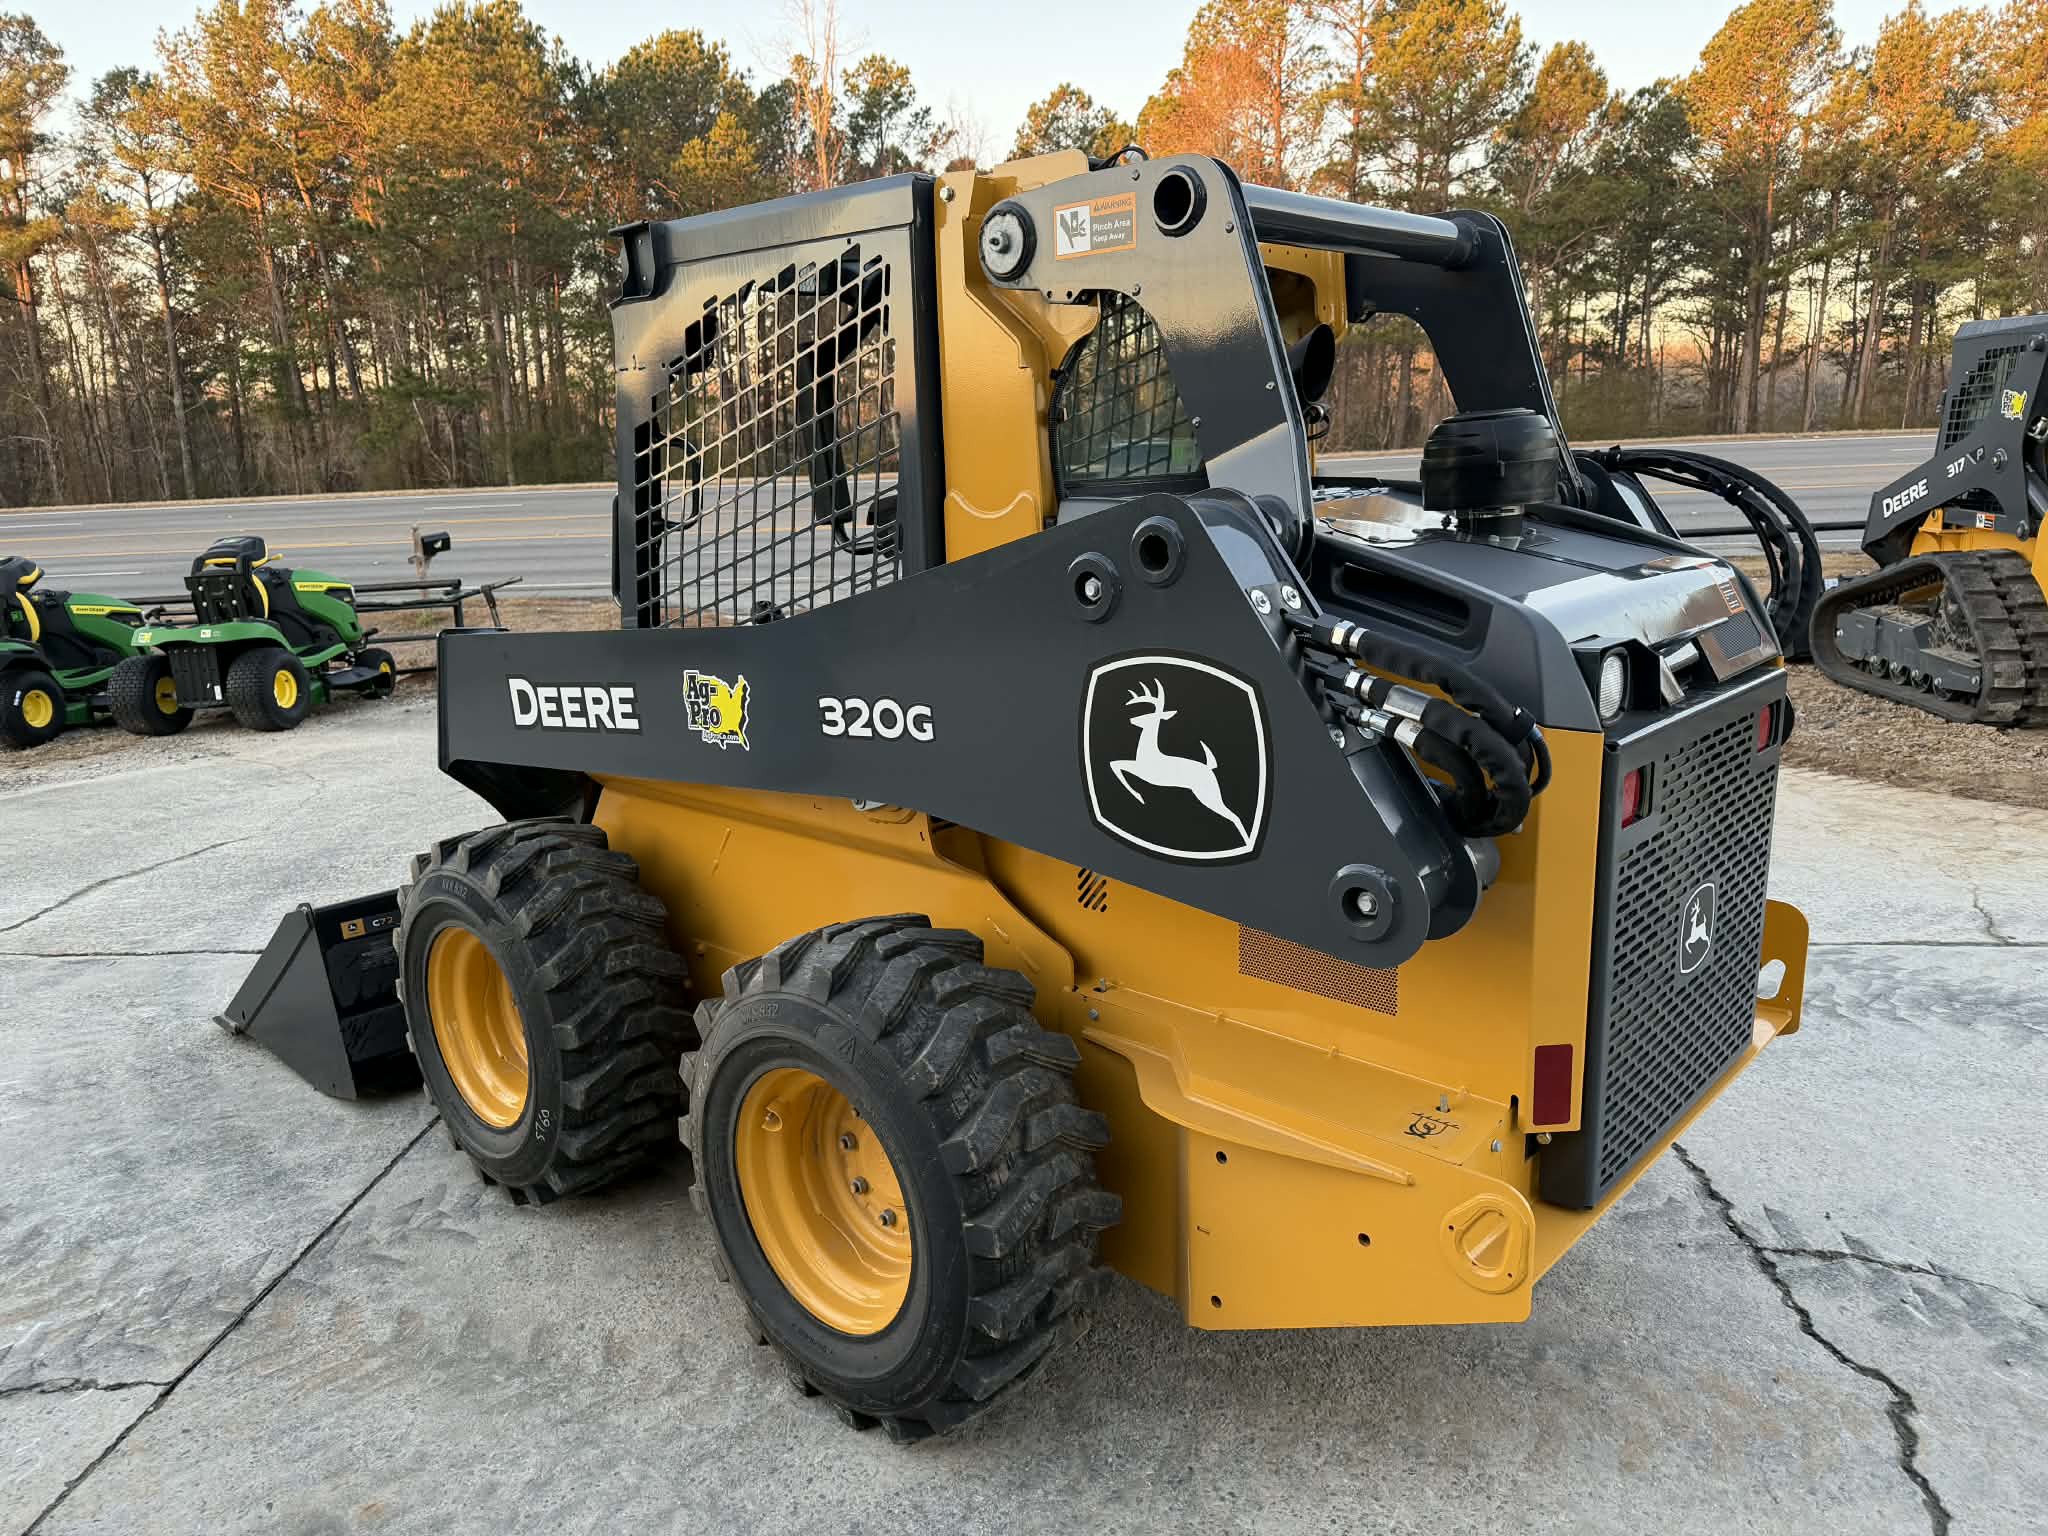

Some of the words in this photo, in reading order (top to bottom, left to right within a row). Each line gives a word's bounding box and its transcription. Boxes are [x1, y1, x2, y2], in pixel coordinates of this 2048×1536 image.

[1103, 199, 1131, 209] WARNING
[1092, 220, 1113, 232] Pinch
[1114, 219, 1131, 229] Area
[1109, 232, 1125, 241] Away
[1946, 456, 1966, 478] 317
[1882, 478, 1929, 519] DEERE
[686, 673, 718, 706] Ag-
[508, 678, 640, 730] DEERE
[687, 700, 722, 728] Pro
[818, 697, 935, 741] 320G
